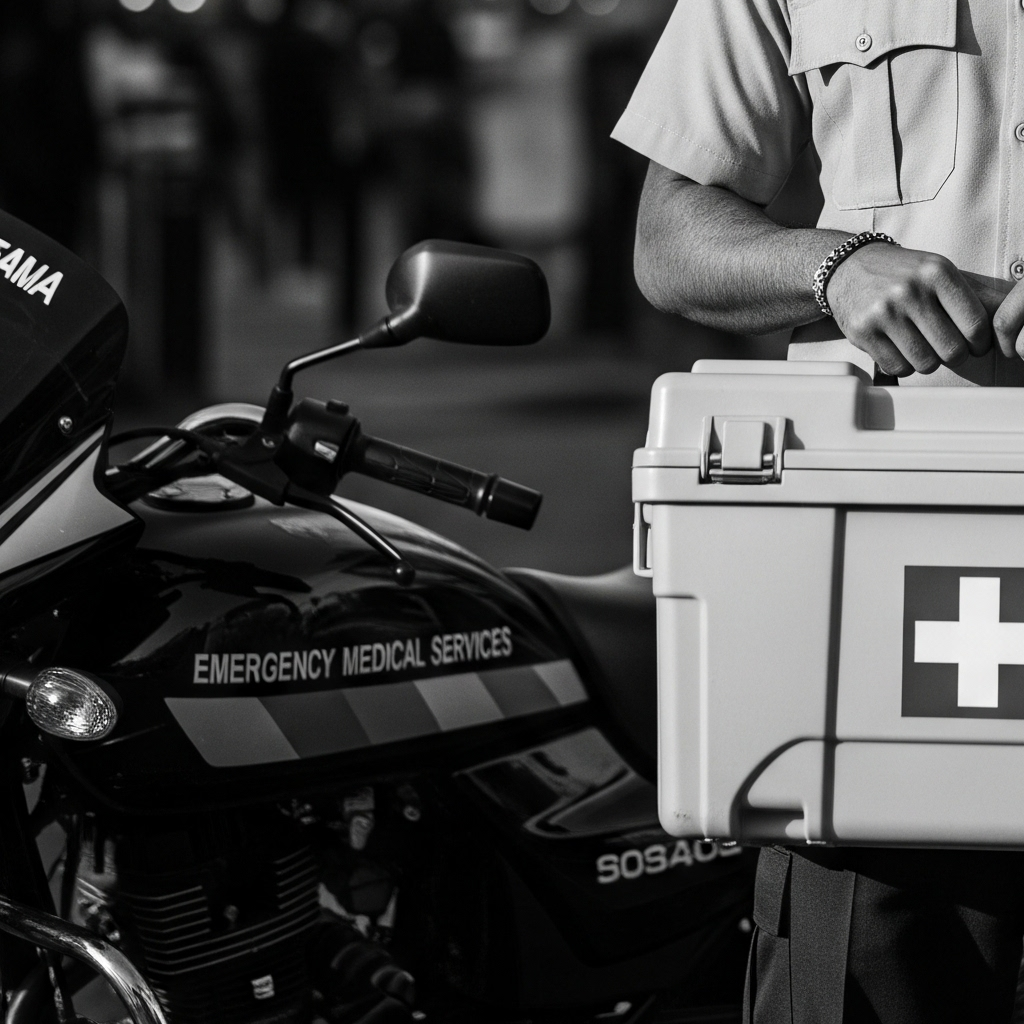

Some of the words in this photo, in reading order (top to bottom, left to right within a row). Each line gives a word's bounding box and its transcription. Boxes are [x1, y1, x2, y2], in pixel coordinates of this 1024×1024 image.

[193, 648, 336, 684] EMERGENCY
[342, 637, 425, 676] MEDICAL
[430, 625, 513, 665] SERVICES
